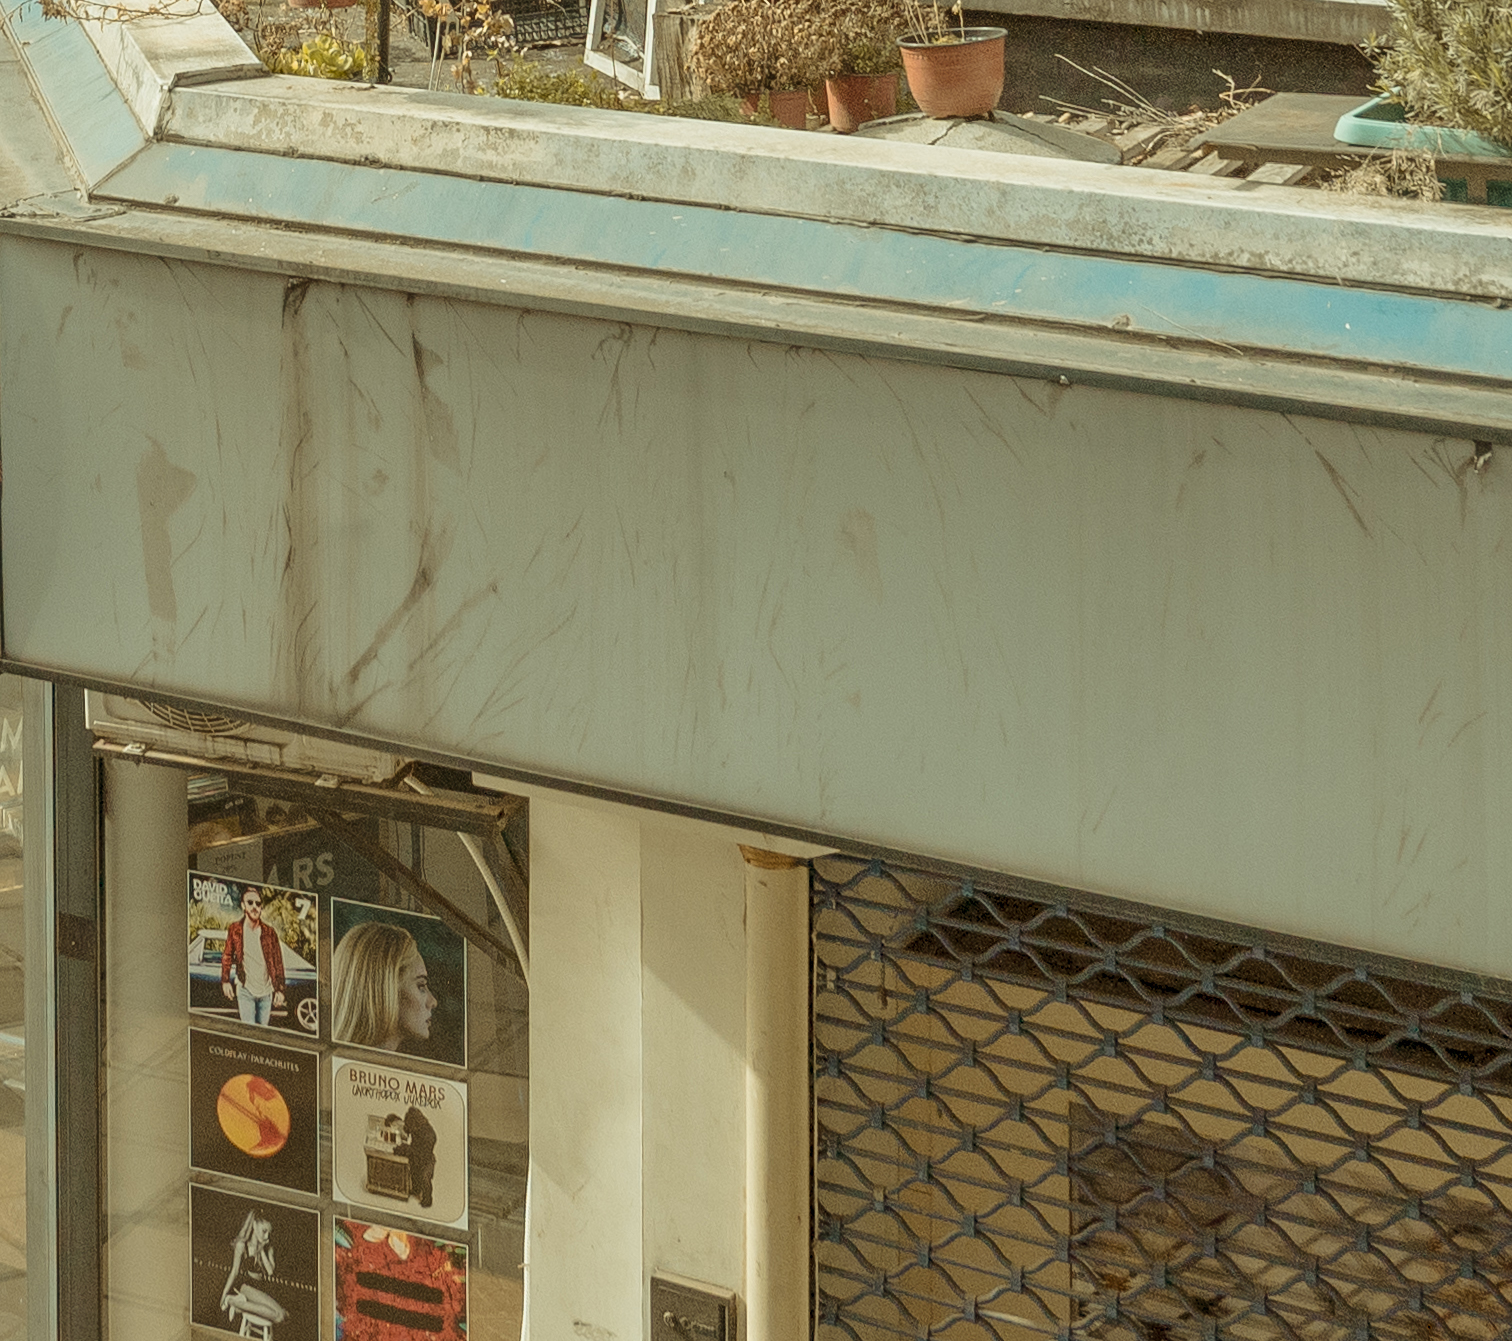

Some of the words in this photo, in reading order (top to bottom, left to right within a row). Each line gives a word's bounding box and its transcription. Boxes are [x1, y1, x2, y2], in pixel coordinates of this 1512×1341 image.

[192, 878, 228, 895] DAVID
[193, 890, 234, 907] GUETTA
[294, 898, 312, 920] 7
[208, 1045, 247, 1061] COLDPLAY
[250, 1053, 300, 1073] PARACHUTES
[349, 1068, 400, 1090] BRUNO
[405, 1079, 446, 1102] MARS
